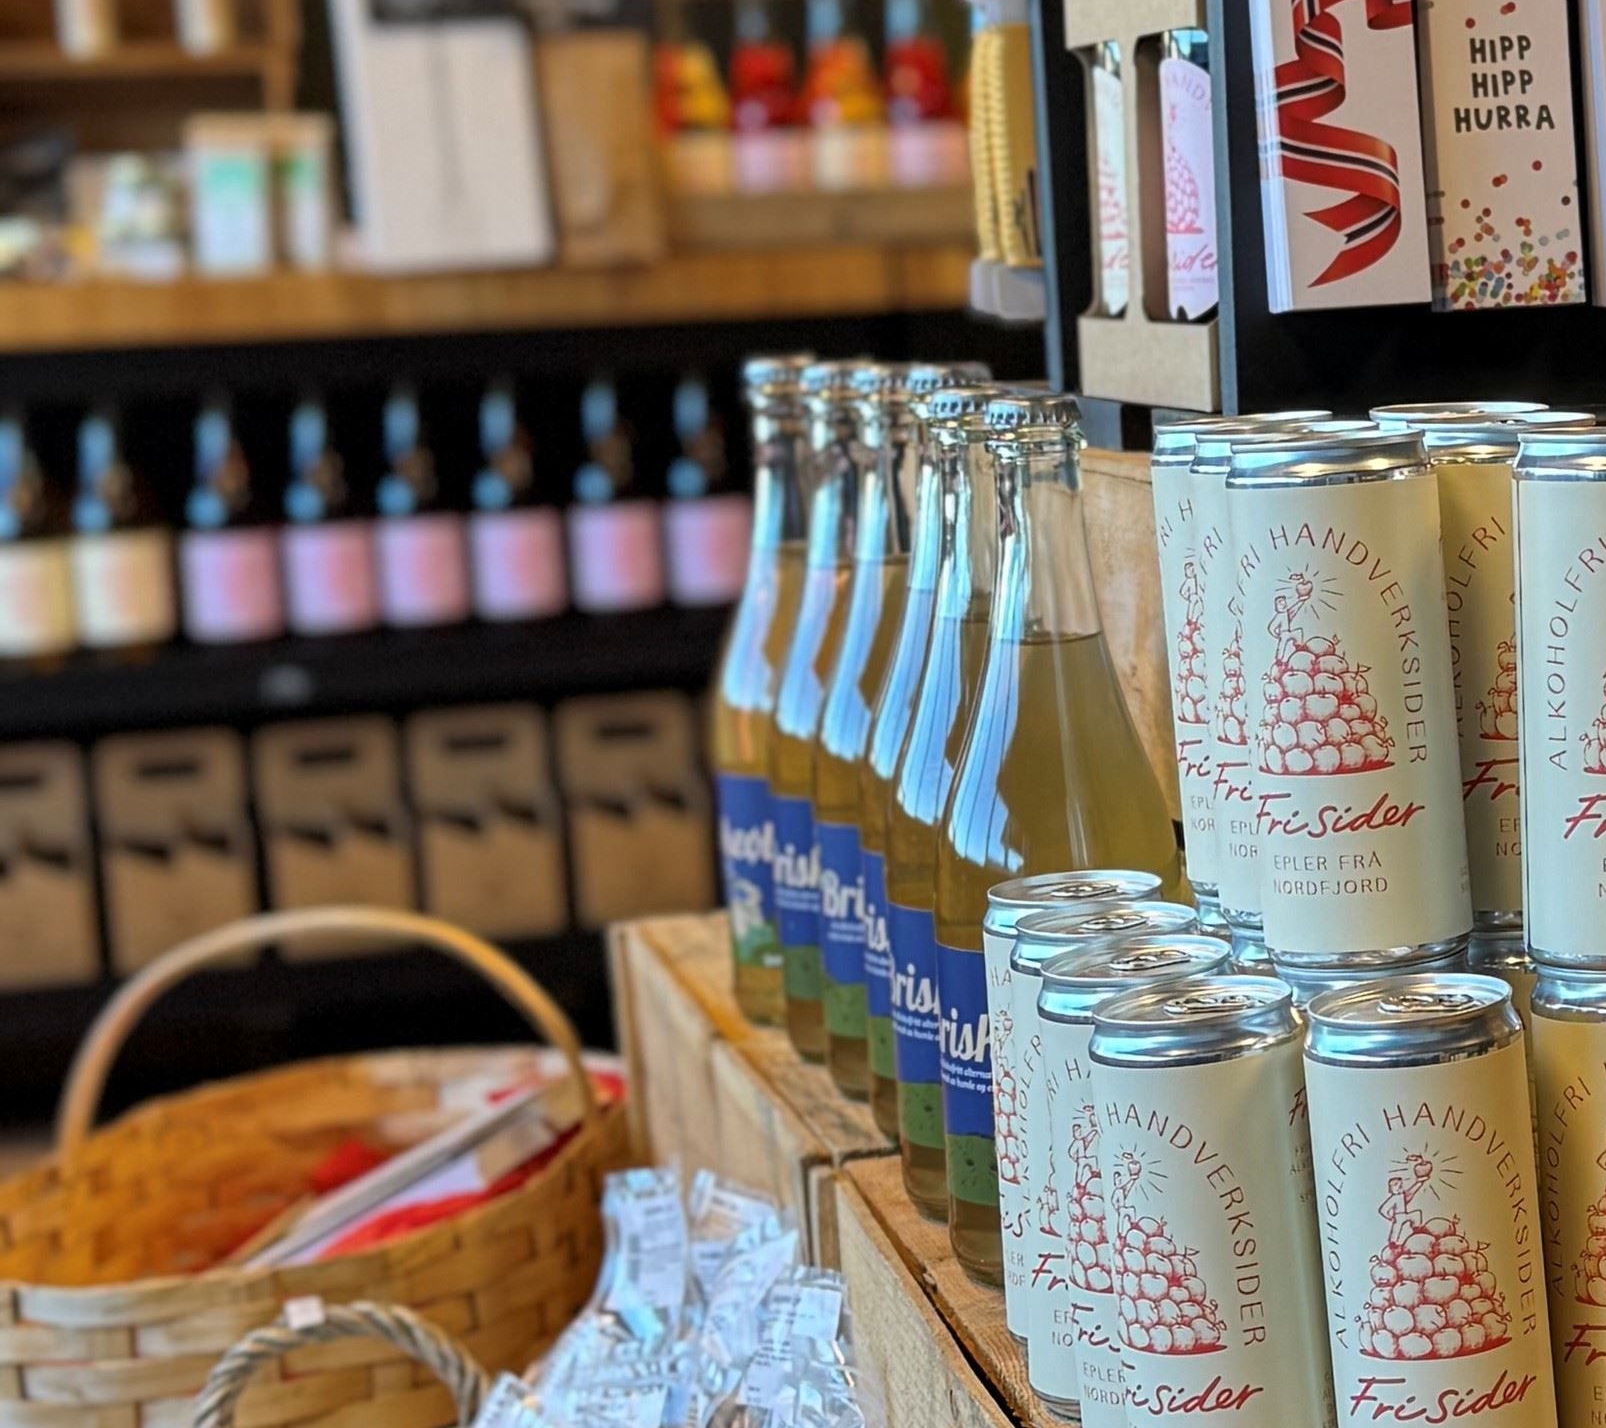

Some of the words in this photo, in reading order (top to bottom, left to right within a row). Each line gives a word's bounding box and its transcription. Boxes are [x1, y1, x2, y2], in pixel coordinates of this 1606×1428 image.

[1469, 34, 1533, 65] HIPP
[1471, 69, 1534, 100] HIPP
[1453, 103, 1555, 134] HURRA
[1269, 522, 1427, 766] HANDVERKSIDER
[1273, 853, 1328, 871] EPLER
[1273, 876, 1389, 896] NORDFJORD
[1105, 1101, 1267, 1348] HANDVERKSIDER
[1324, 1119, 1371, 1349] ALKOHOLFRI
[1384, 1102, 1538, 1338] HANDVERKSIDER
